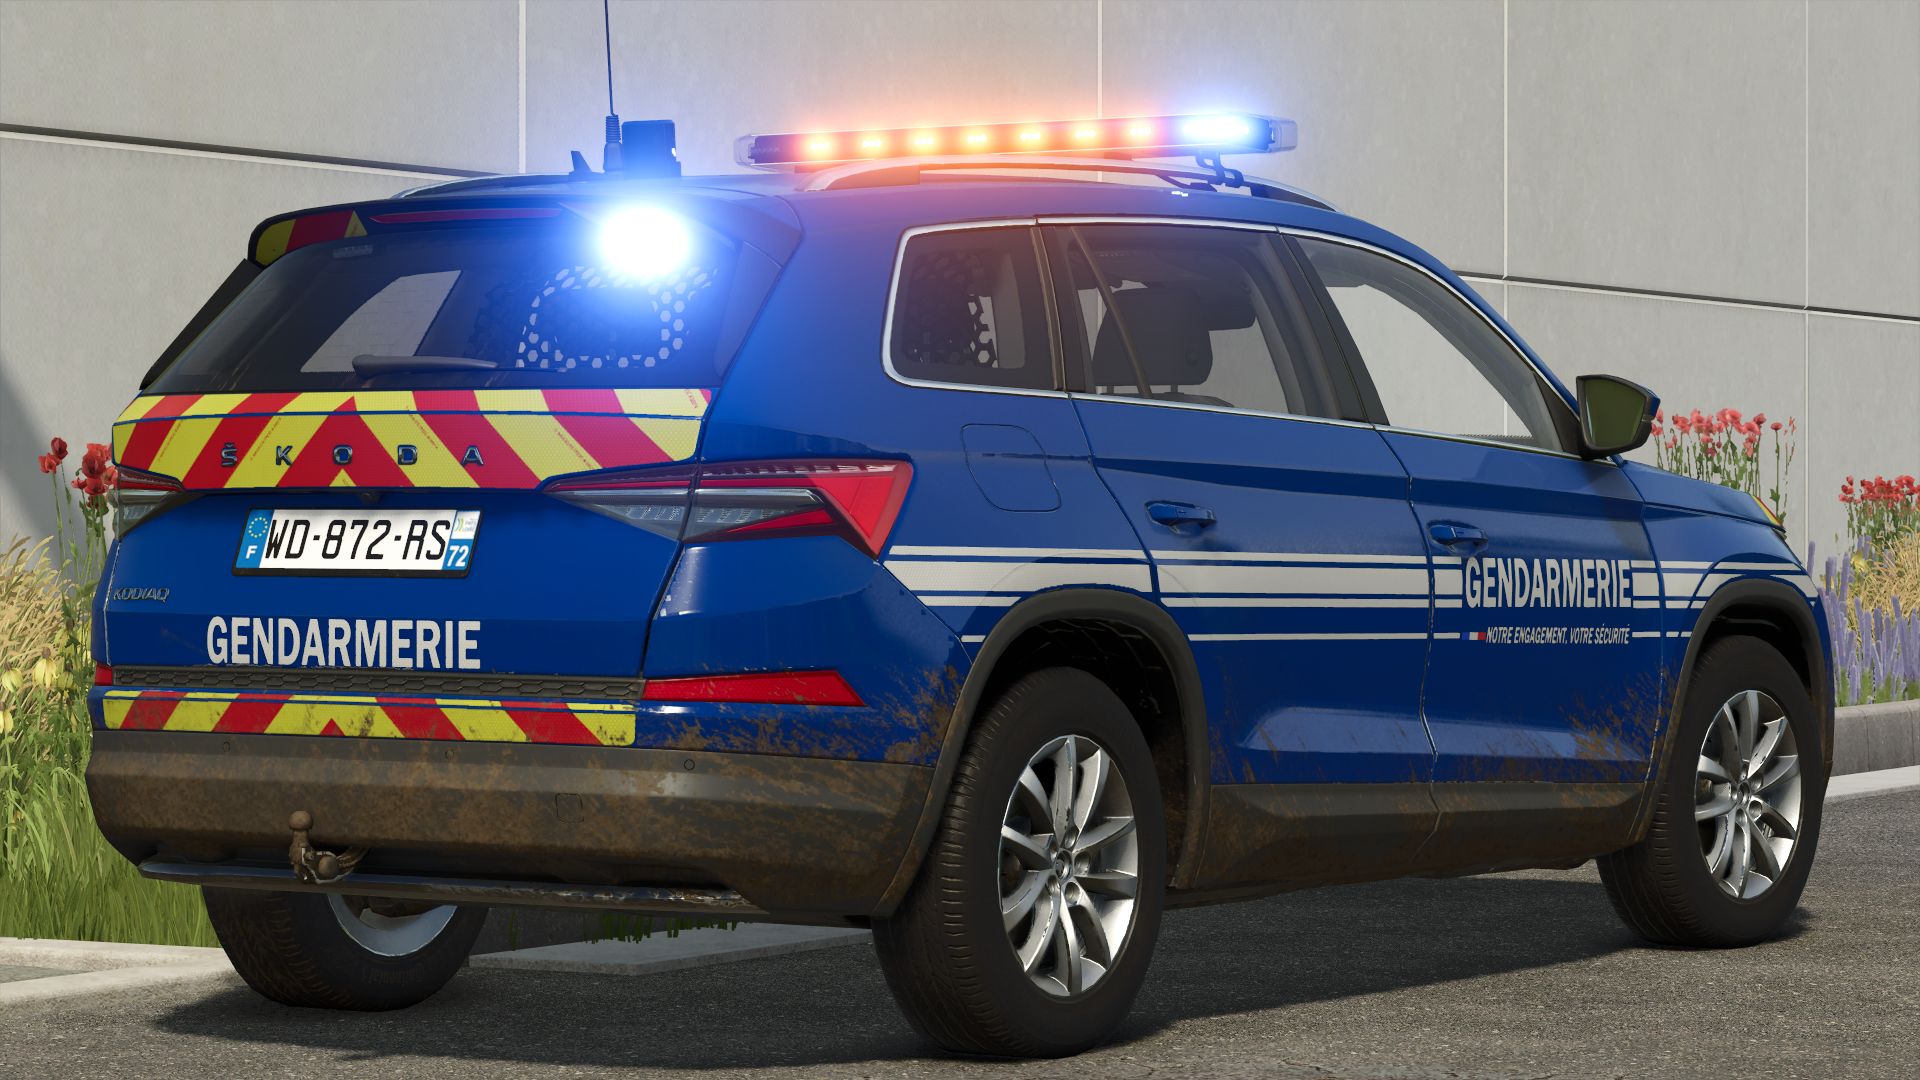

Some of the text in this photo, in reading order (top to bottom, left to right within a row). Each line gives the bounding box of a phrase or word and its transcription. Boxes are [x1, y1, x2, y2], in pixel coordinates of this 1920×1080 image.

[221, 442, 484, 467] ŠKODA
[265, 519, 450, 560] WD-872-RS
[246, 545, 257, 559] F
[447, 545, 469, 567] 72
[1465, 556, 1631, 608] GENDARMERIE
[113, 587, 170, 603] KODIAQ
[206, 616, 481, 669] GENDARMERIE
[1486, 626, 1513, 644] NOTRE
[1570, 627, 1595, 644] VOTRE
[1595, 623, 1630, 645] SÉCURITÉ
